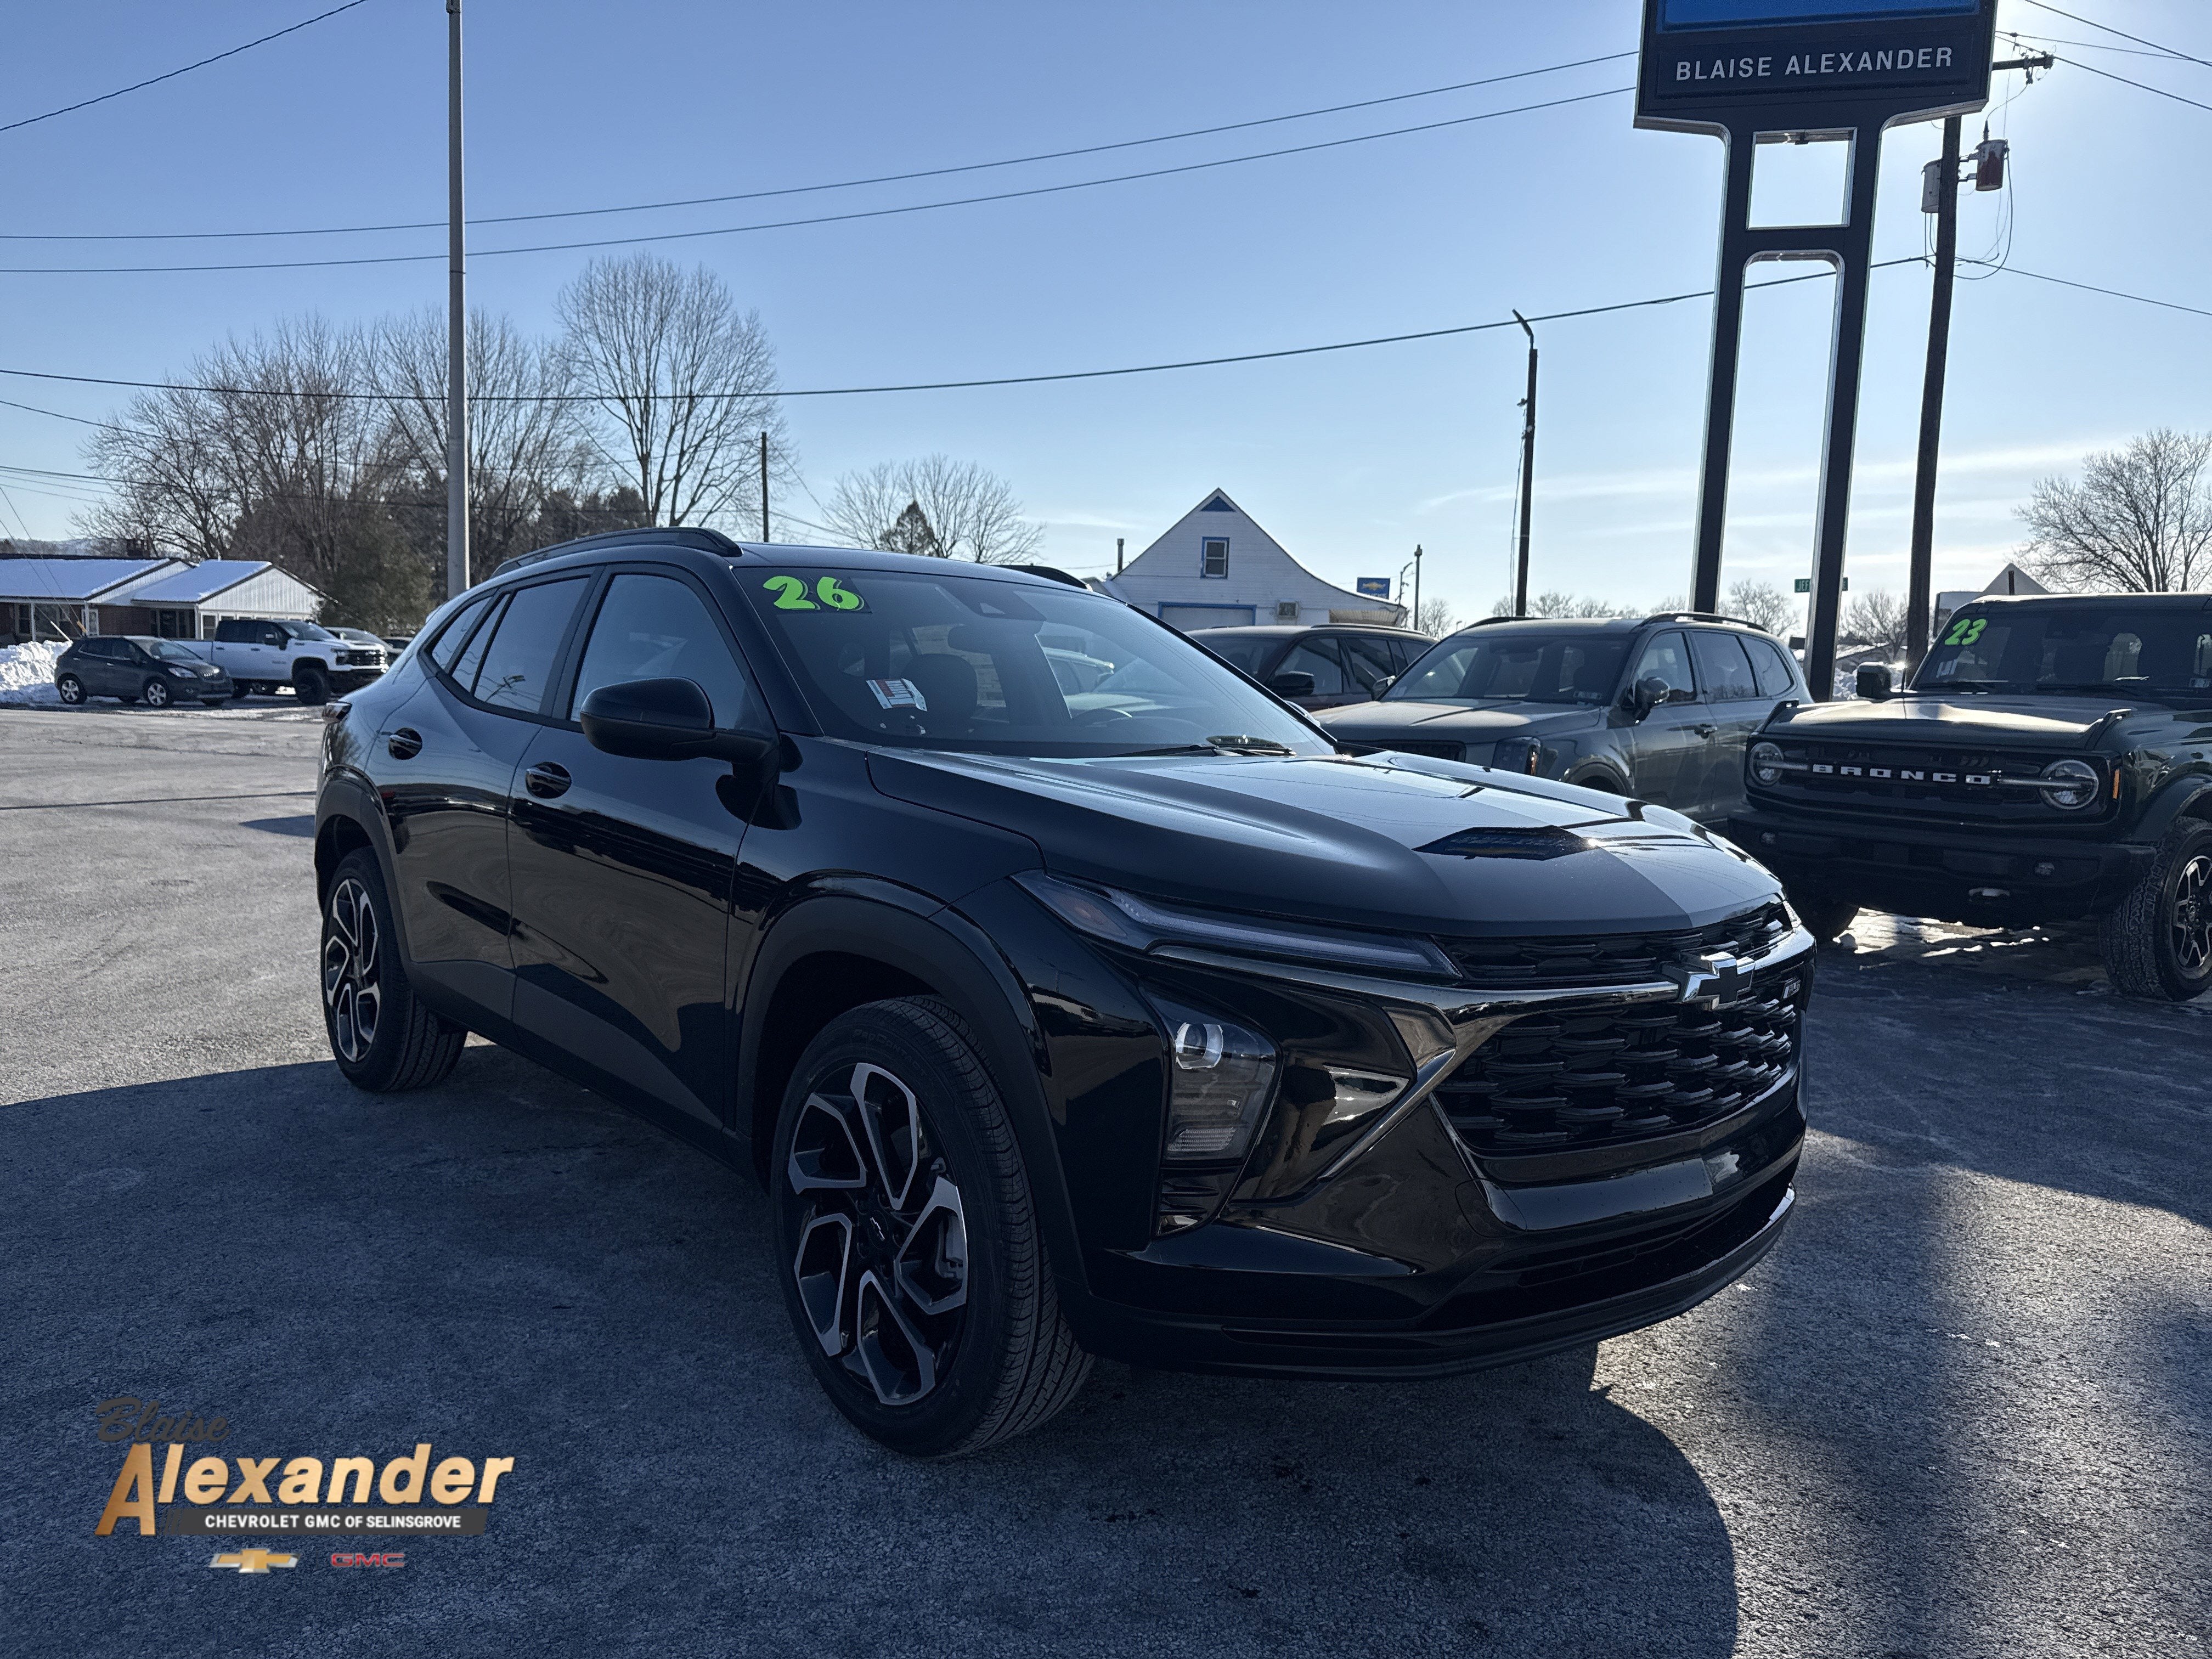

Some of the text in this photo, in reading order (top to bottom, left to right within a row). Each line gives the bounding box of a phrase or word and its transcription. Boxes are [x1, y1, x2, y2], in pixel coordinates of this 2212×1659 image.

[1675, 47, 1953, 81] BLAISE ALEXANDER
[763, 575, 865, 611] 26
[1944, 618, 1988, 646] 23
[1812, 764, 1991, 785] BRONCO
